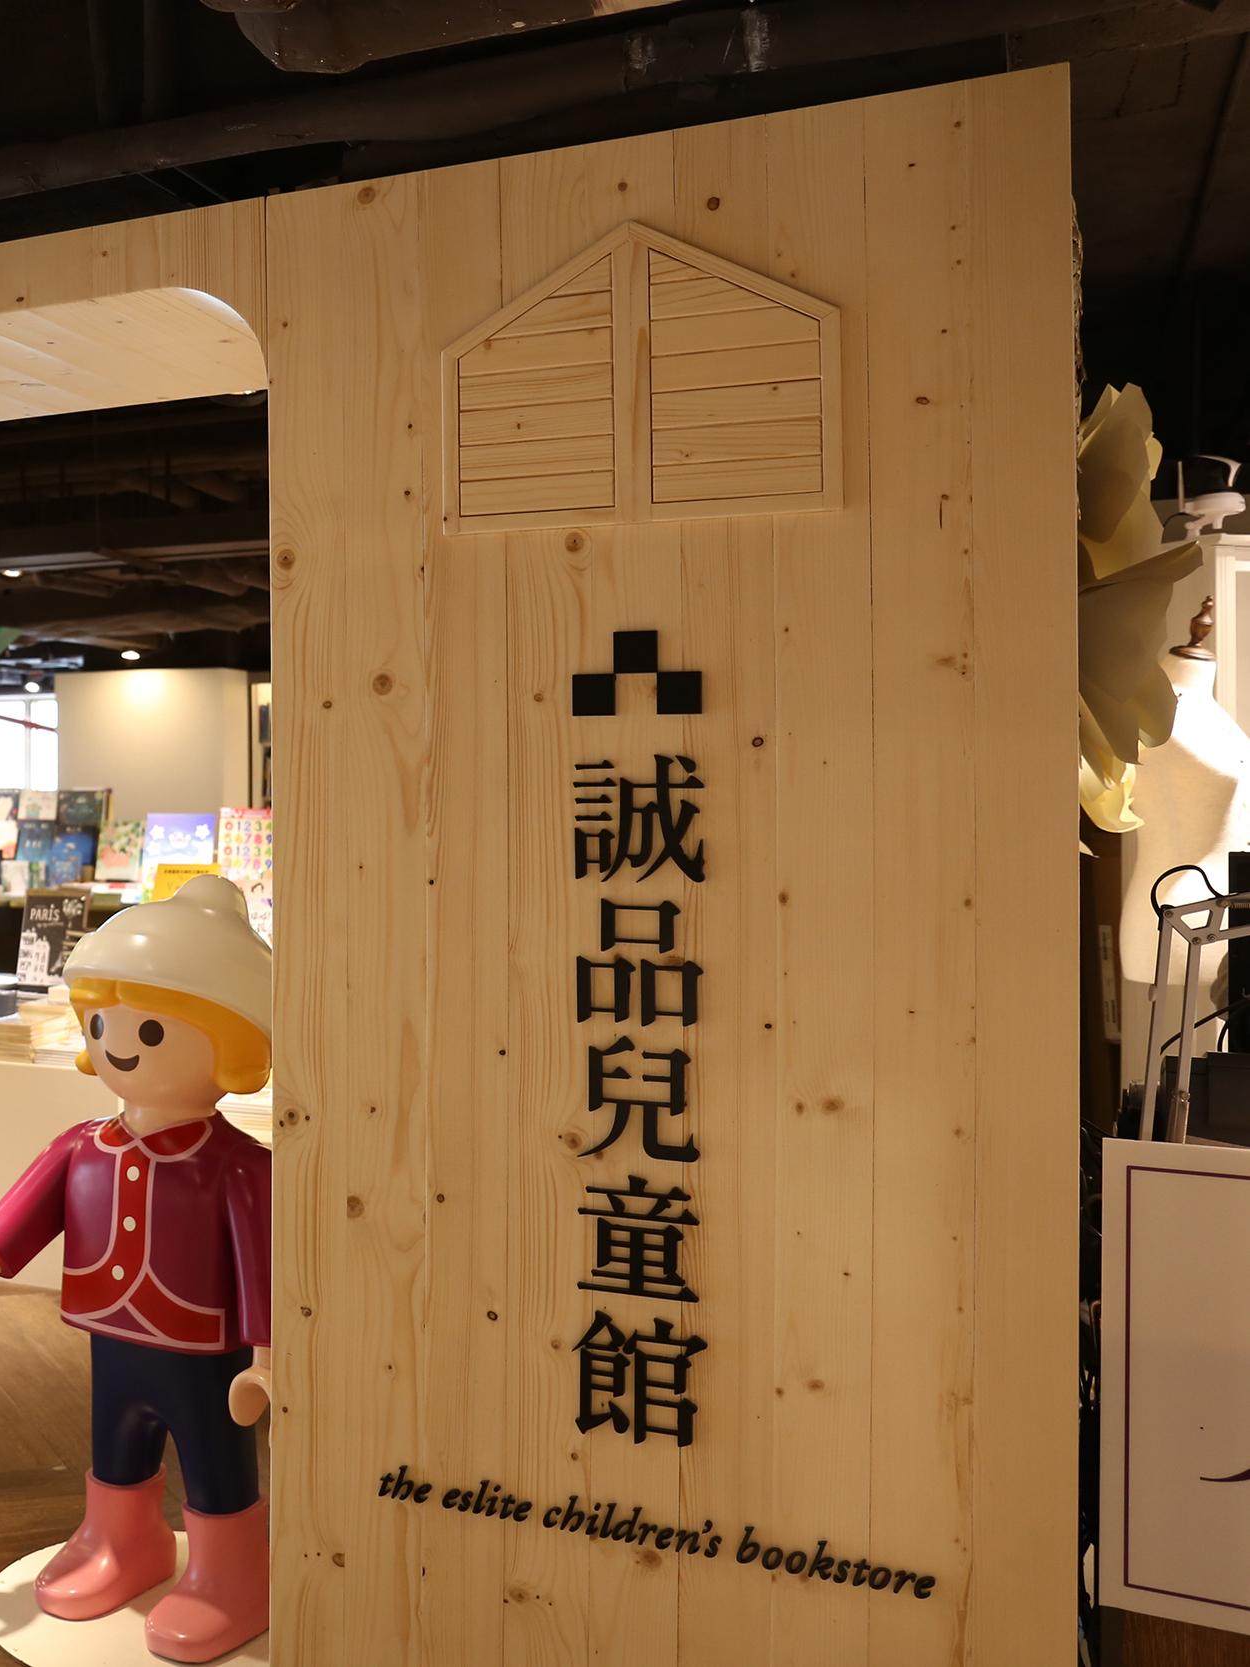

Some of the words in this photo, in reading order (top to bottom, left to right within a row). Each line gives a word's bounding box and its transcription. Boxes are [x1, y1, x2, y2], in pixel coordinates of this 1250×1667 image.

[30, 904, 60, 921] PARIS
[572, 754, 708, 1448] 誠品兒童館
[377, 1464, 433, 1504] the
[441, 1479, 534, 1523] eslite
[542, 1494, 724, 1560] children’s
[735, 1525, 938, 1600] bookstore
